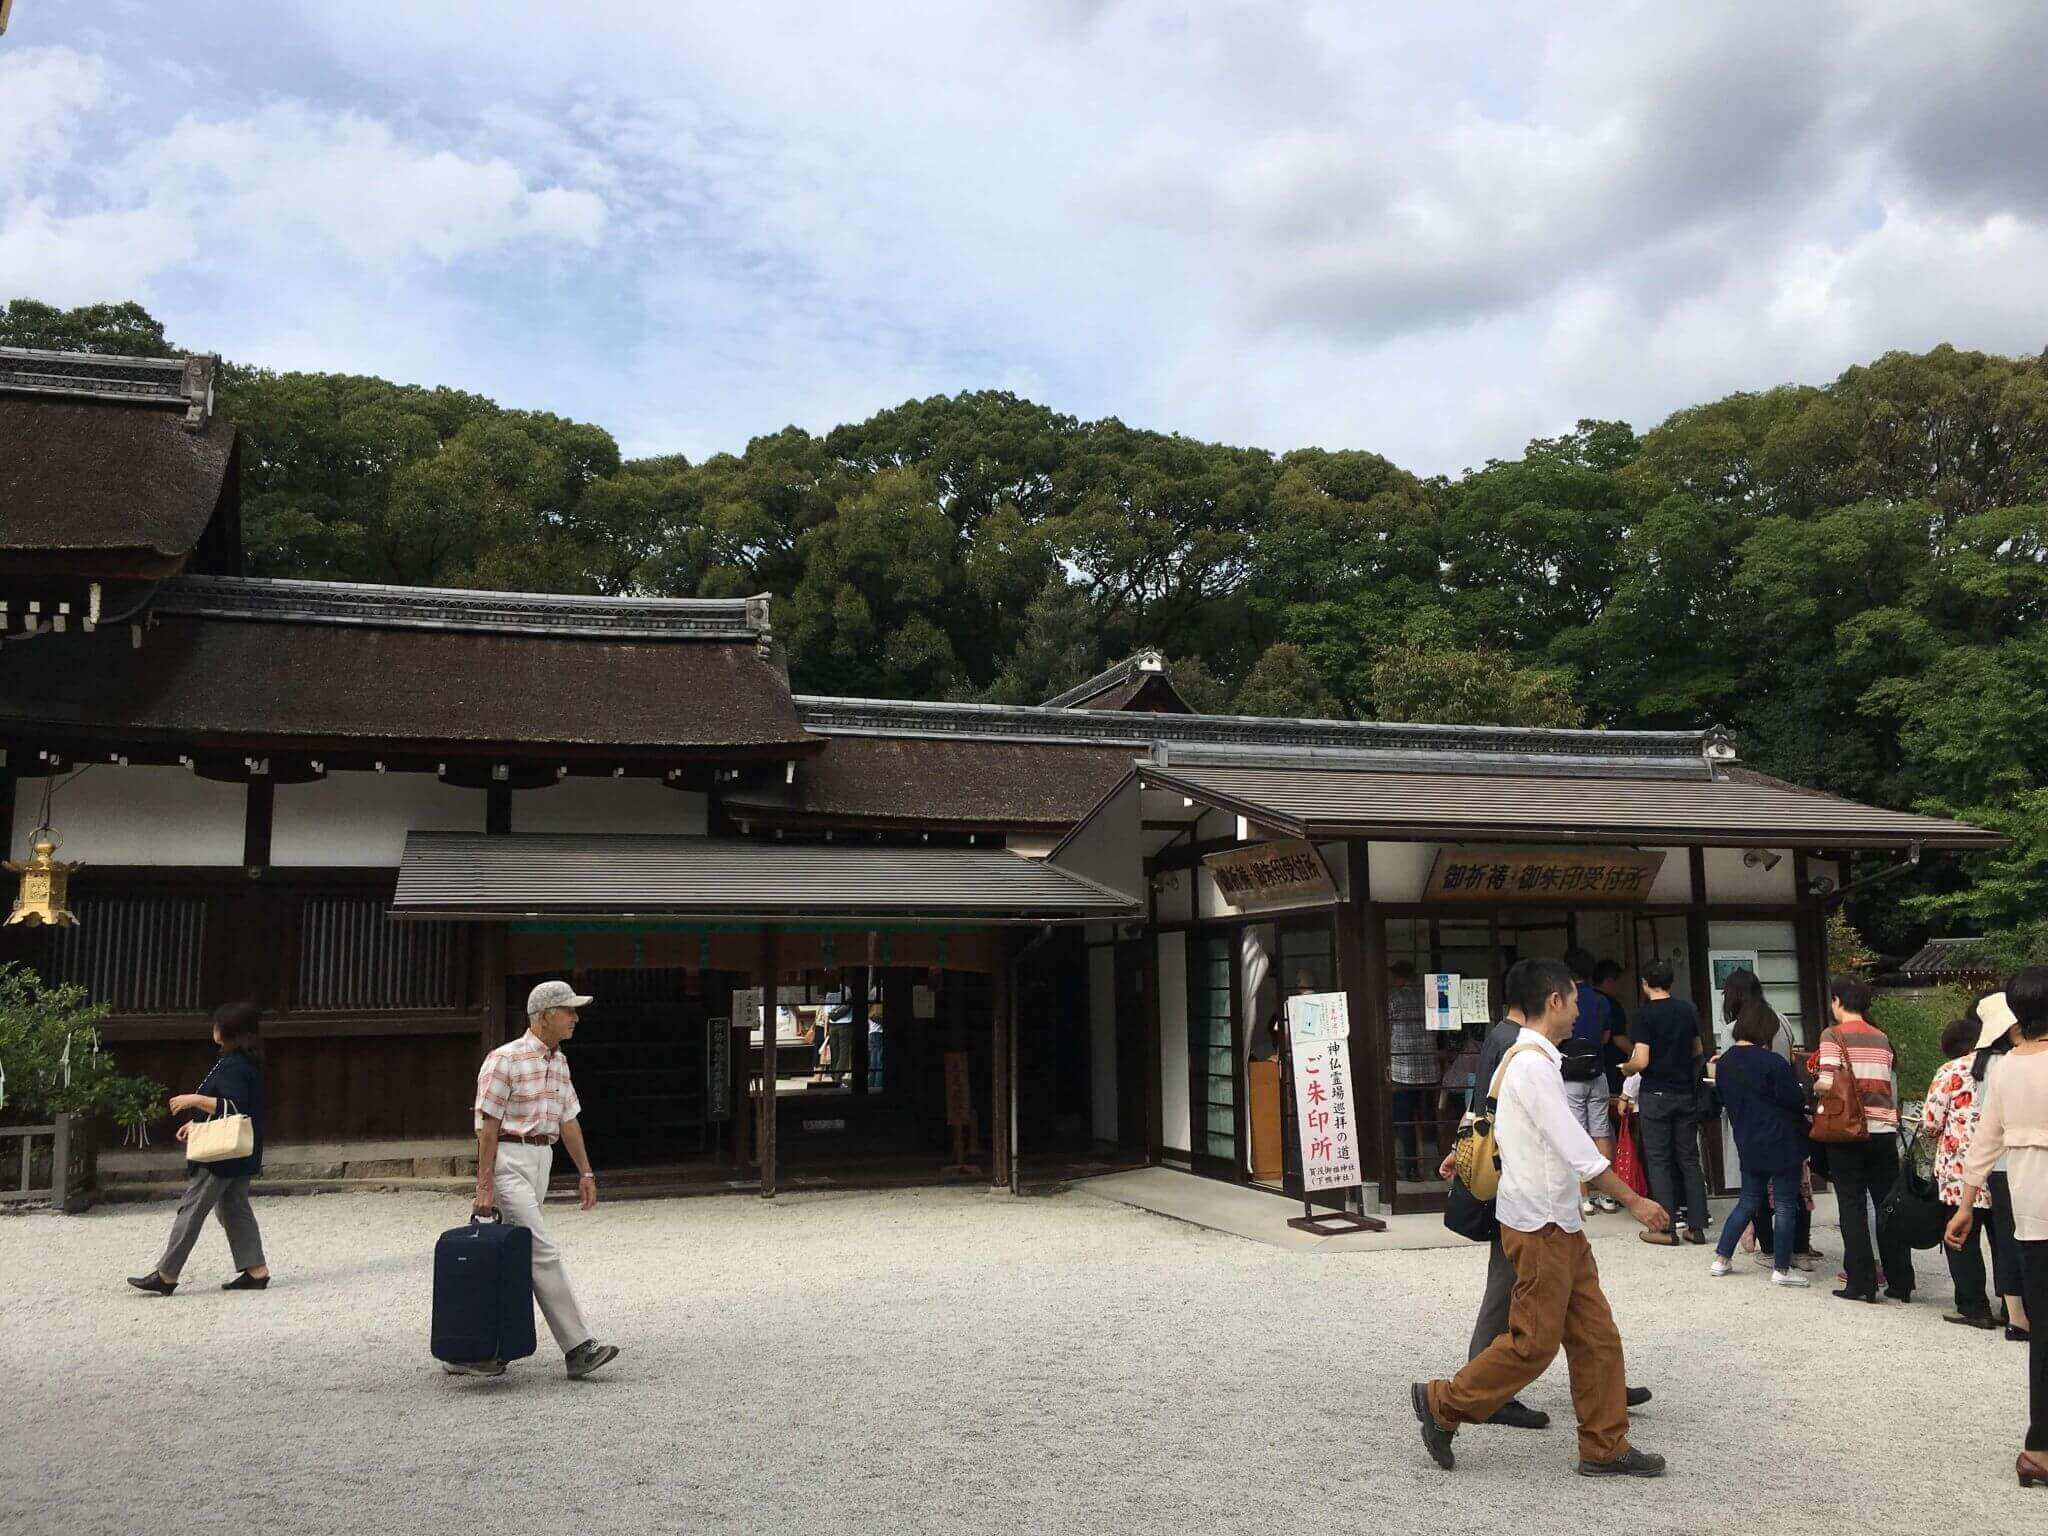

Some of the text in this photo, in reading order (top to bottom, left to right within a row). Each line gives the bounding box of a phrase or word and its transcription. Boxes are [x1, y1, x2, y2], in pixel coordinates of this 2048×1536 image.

[1305, 1054, 1332, 1161] ご朱印所
[1327, 1041, 1350, 1159] 神仏霊場巡拝の道
